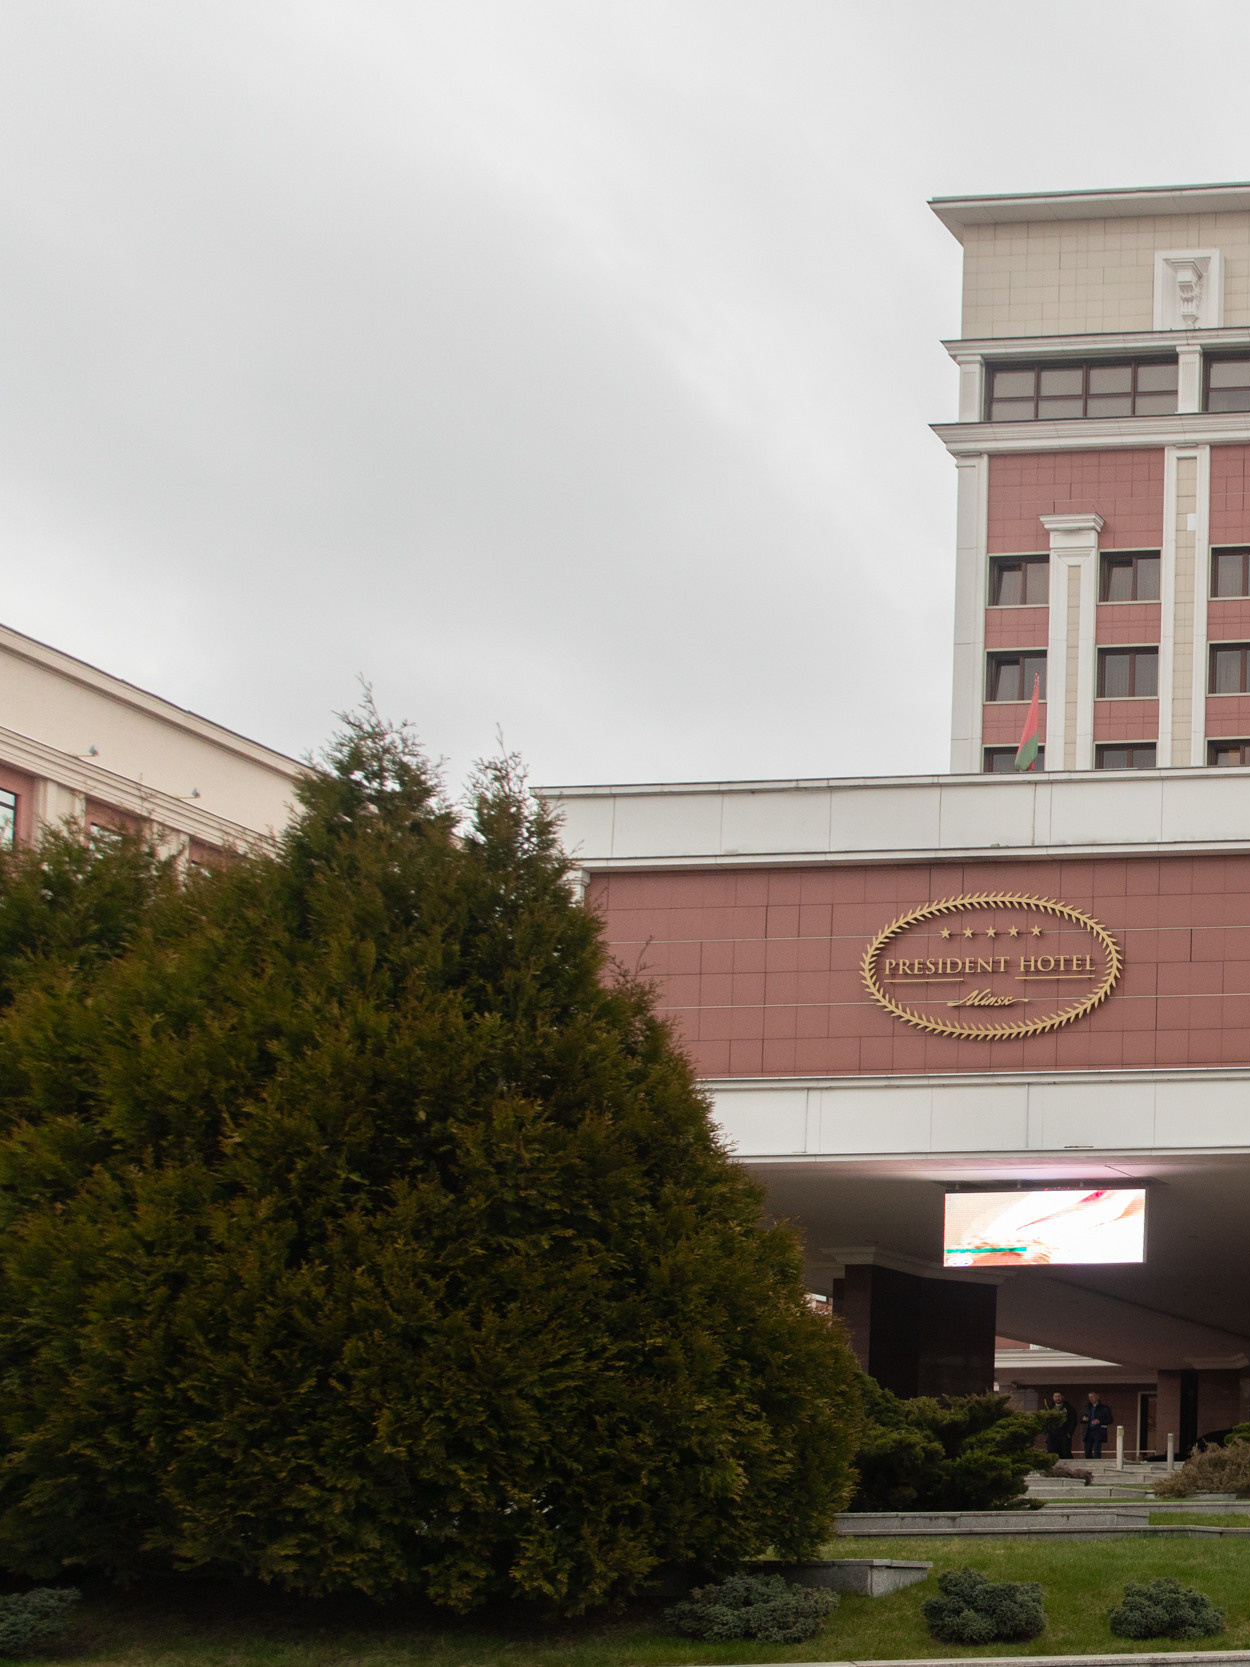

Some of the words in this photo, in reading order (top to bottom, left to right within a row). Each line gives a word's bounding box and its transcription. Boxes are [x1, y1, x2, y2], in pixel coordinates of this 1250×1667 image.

[884, 956, 1010, 975] PRESIDENT
[1019, 955, 1096, 972] HOTEL
[947, 988, 1029, 1007] Minsk
